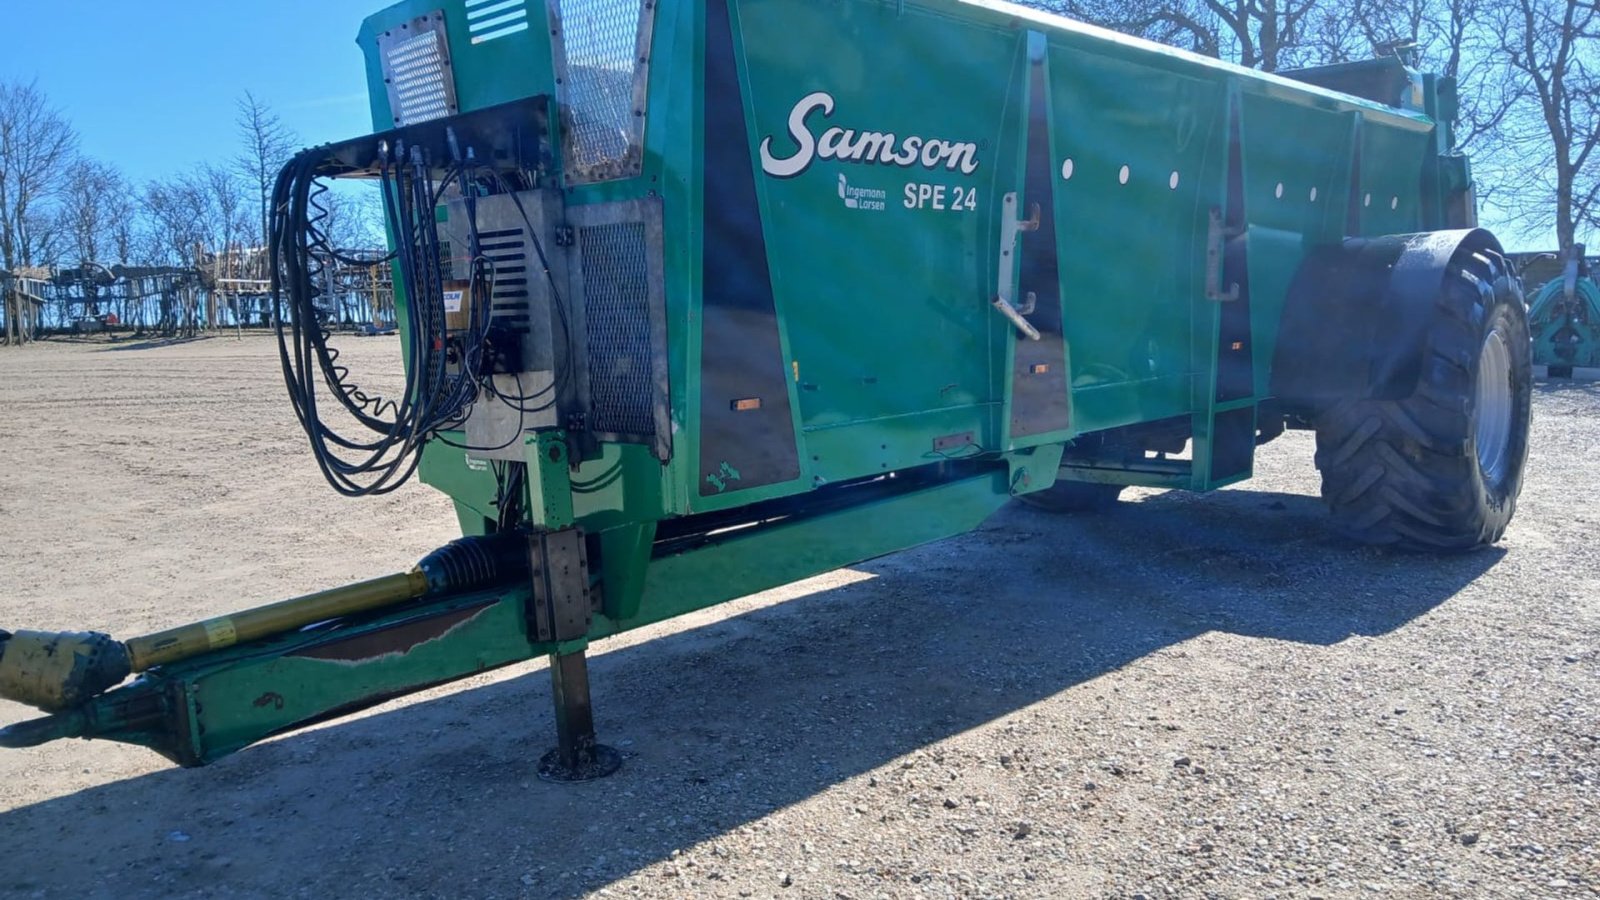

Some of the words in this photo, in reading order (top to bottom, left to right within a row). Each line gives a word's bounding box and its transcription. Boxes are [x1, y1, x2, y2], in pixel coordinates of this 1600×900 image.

[759, 91, 979, 179] Samson
[846, 185, 886, 199] Ingemann
[903, 182, 946, 210] SPE
[951, 186, 977, 211] 24
[859, 199, 885, 211] Larsen
